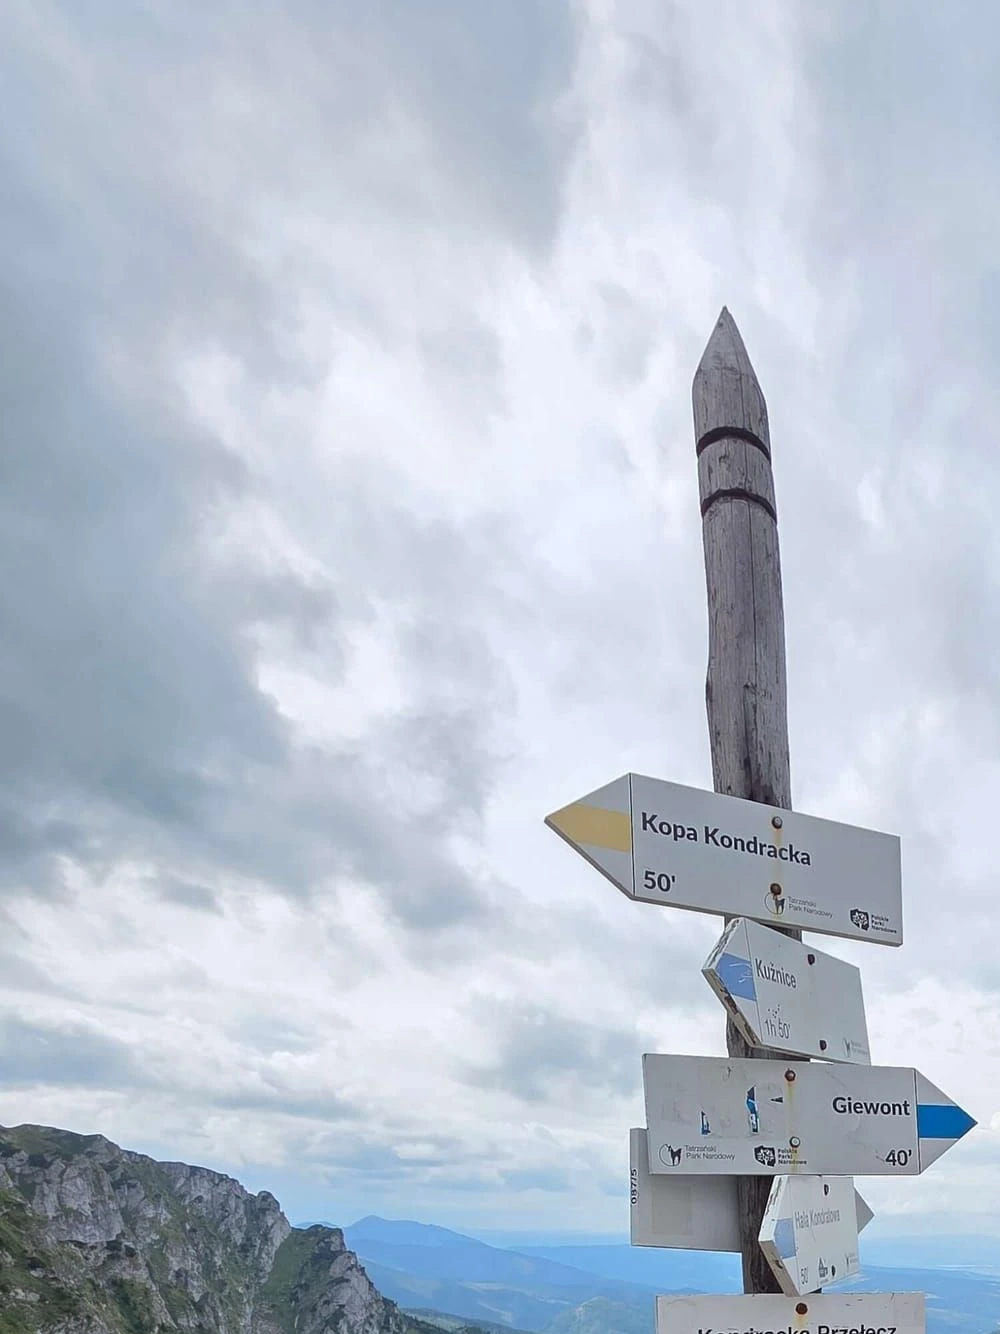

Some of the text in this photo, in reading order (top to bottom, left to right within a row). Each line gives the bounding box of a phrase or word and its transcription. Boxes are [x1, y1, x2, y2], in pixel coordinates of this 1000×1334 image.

[641, 812, 811, 866] Kopa Kondracka
[643, 870, 676, 892] 50'
[832, 1096, 910, 1116] Giewont
[885, 1149, 912, 1166] 40'
